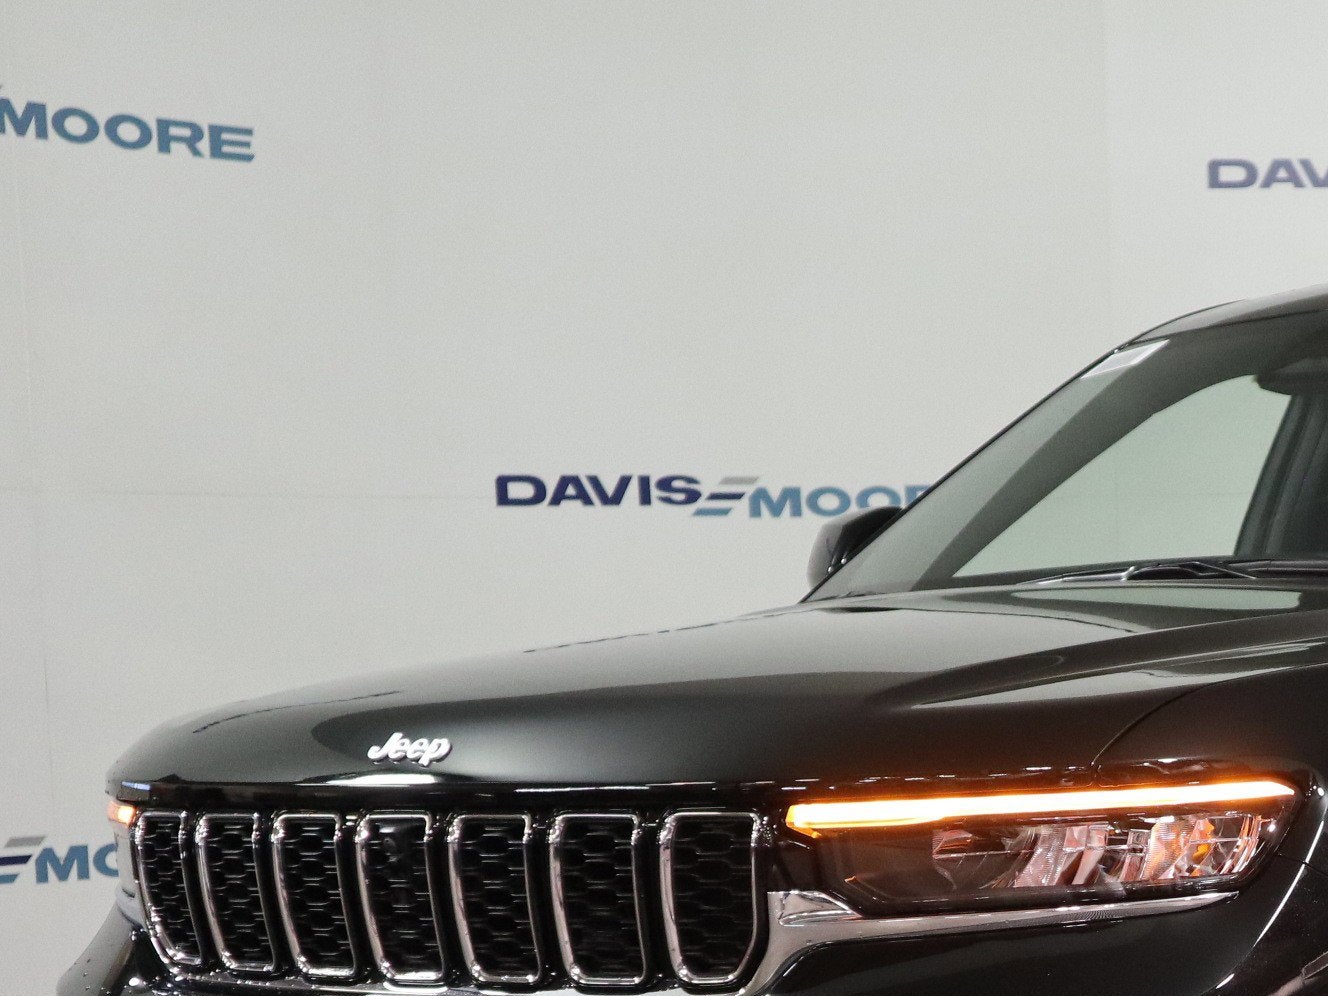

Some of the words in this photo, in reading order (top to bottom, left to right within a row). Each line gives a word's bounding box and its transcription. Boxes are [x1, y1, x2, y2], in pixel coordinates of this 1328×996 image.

[0, 98, 255, 162] MOORE
[495, 474, 701, 506] DAVIS
[367, 732, 453, 767] Jeep
